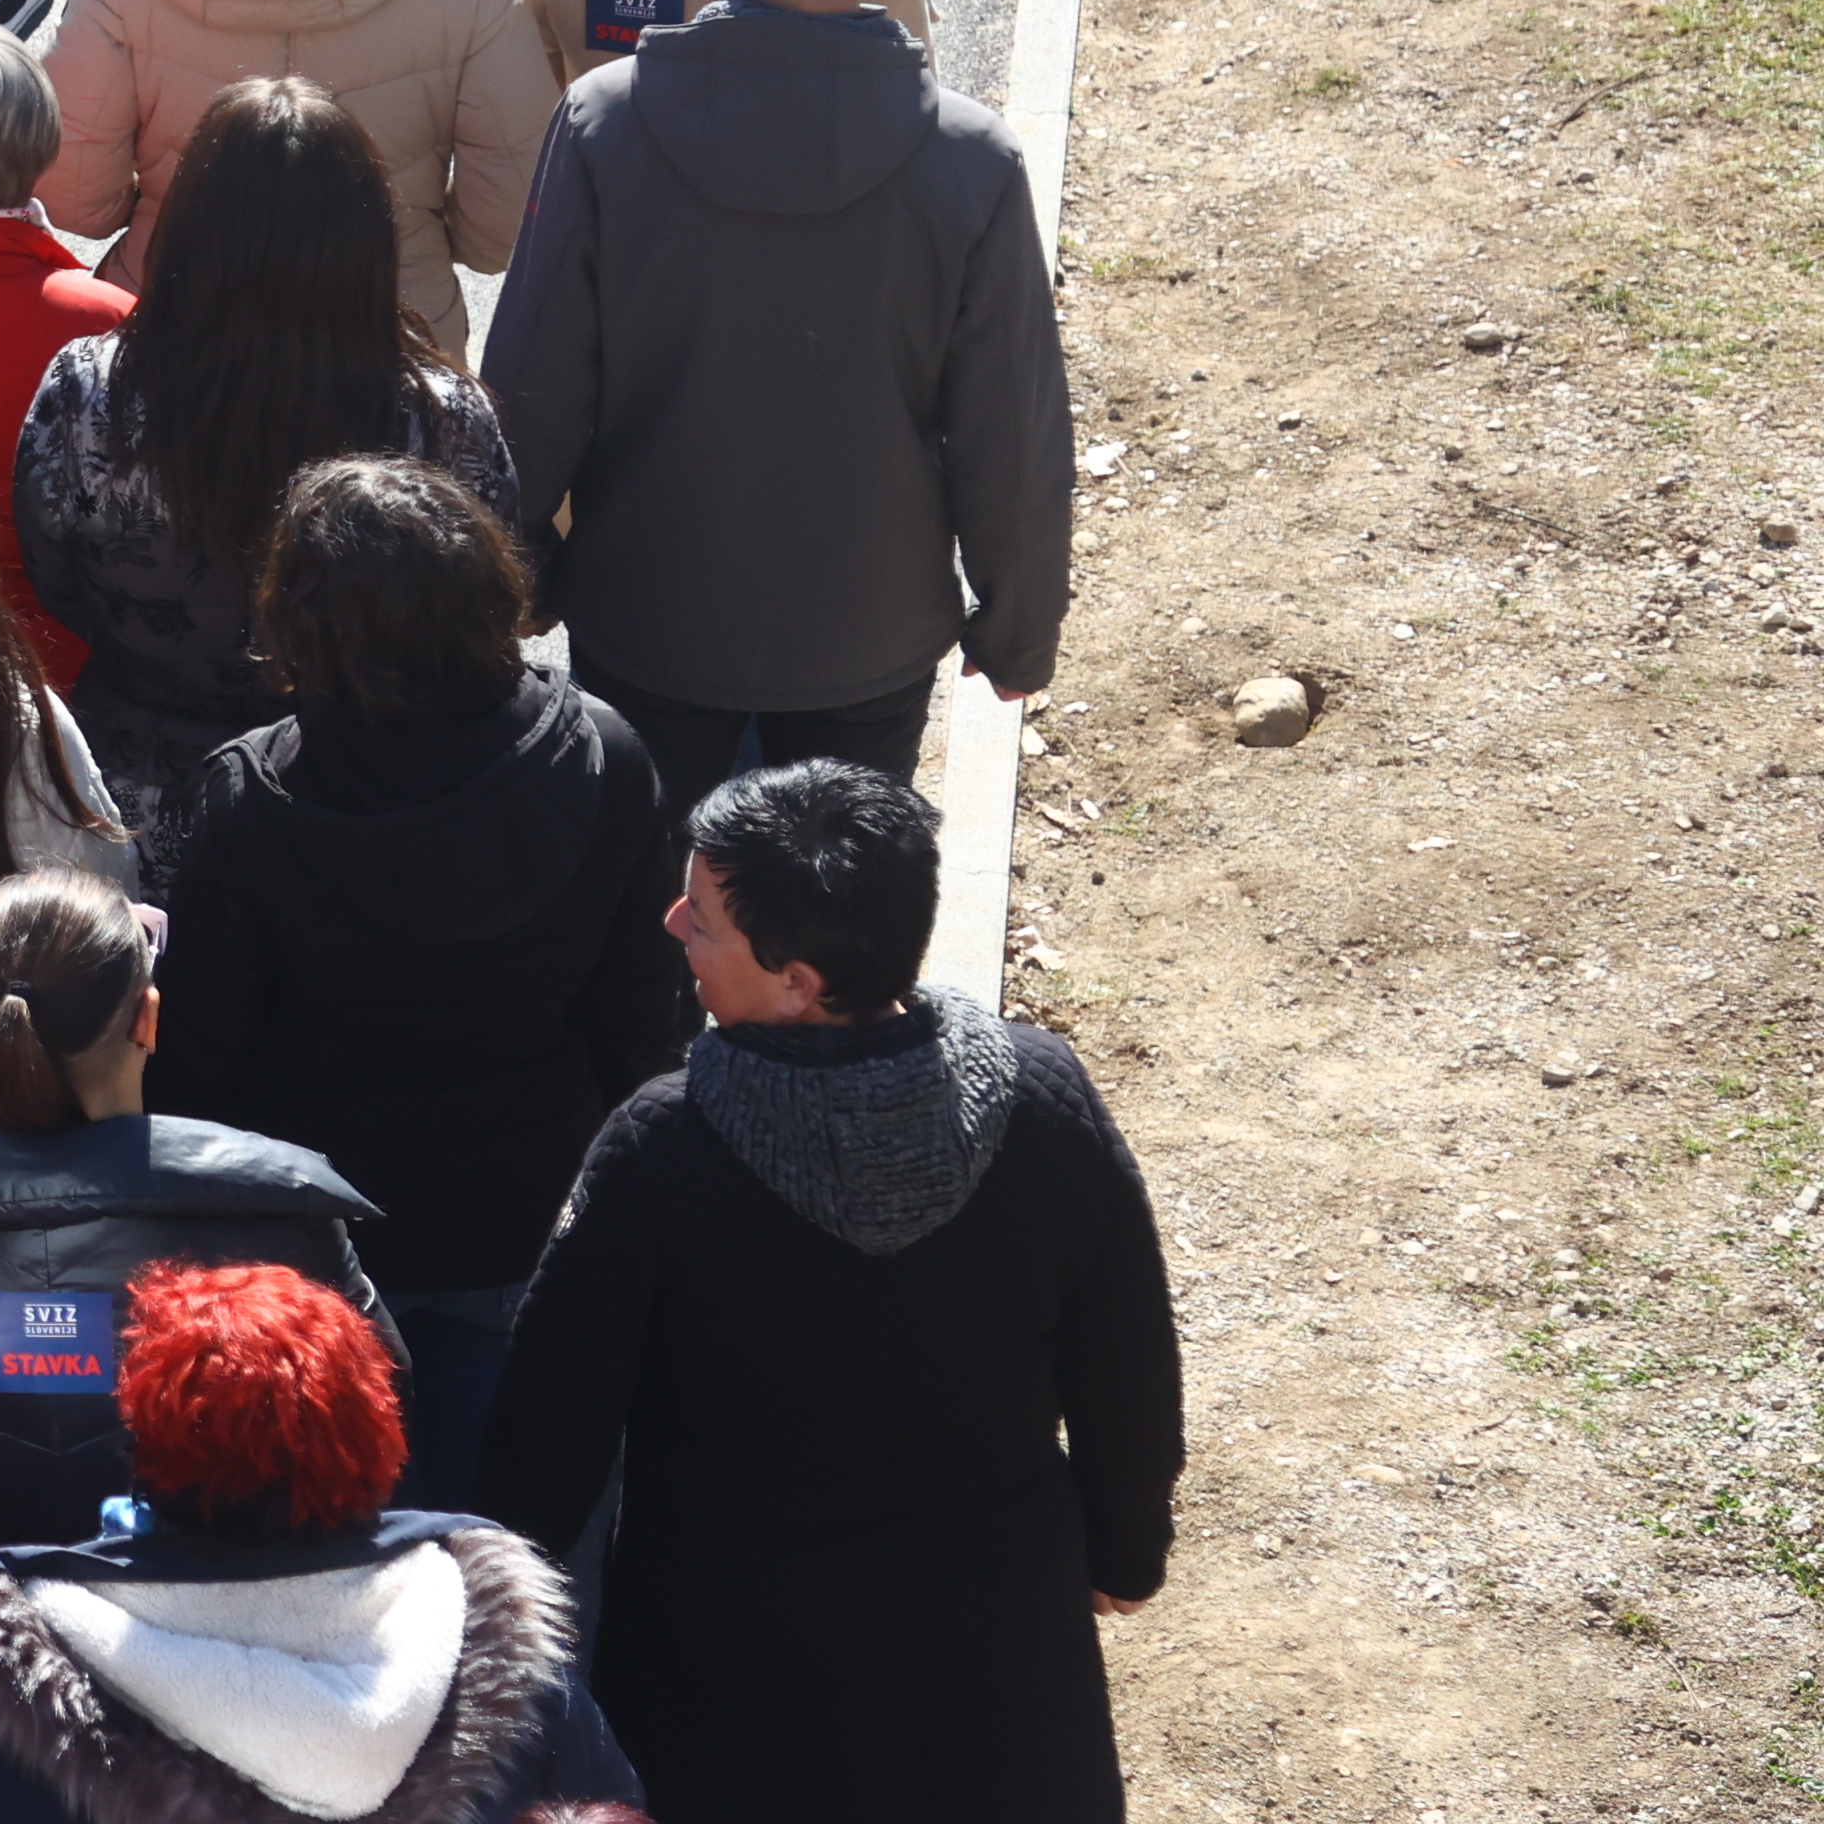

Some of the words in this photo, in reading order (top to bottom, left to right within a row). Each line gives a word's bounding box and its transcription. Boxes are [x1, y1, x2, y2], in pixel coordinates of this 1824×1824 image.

[595, 23, 641, 44] STAV
[25, 1307, 77, 1323] SVIZ
[25, 1326, 77, 1334] SLOVENIJE
[2, 1352, 103, 1376] STAVKA
